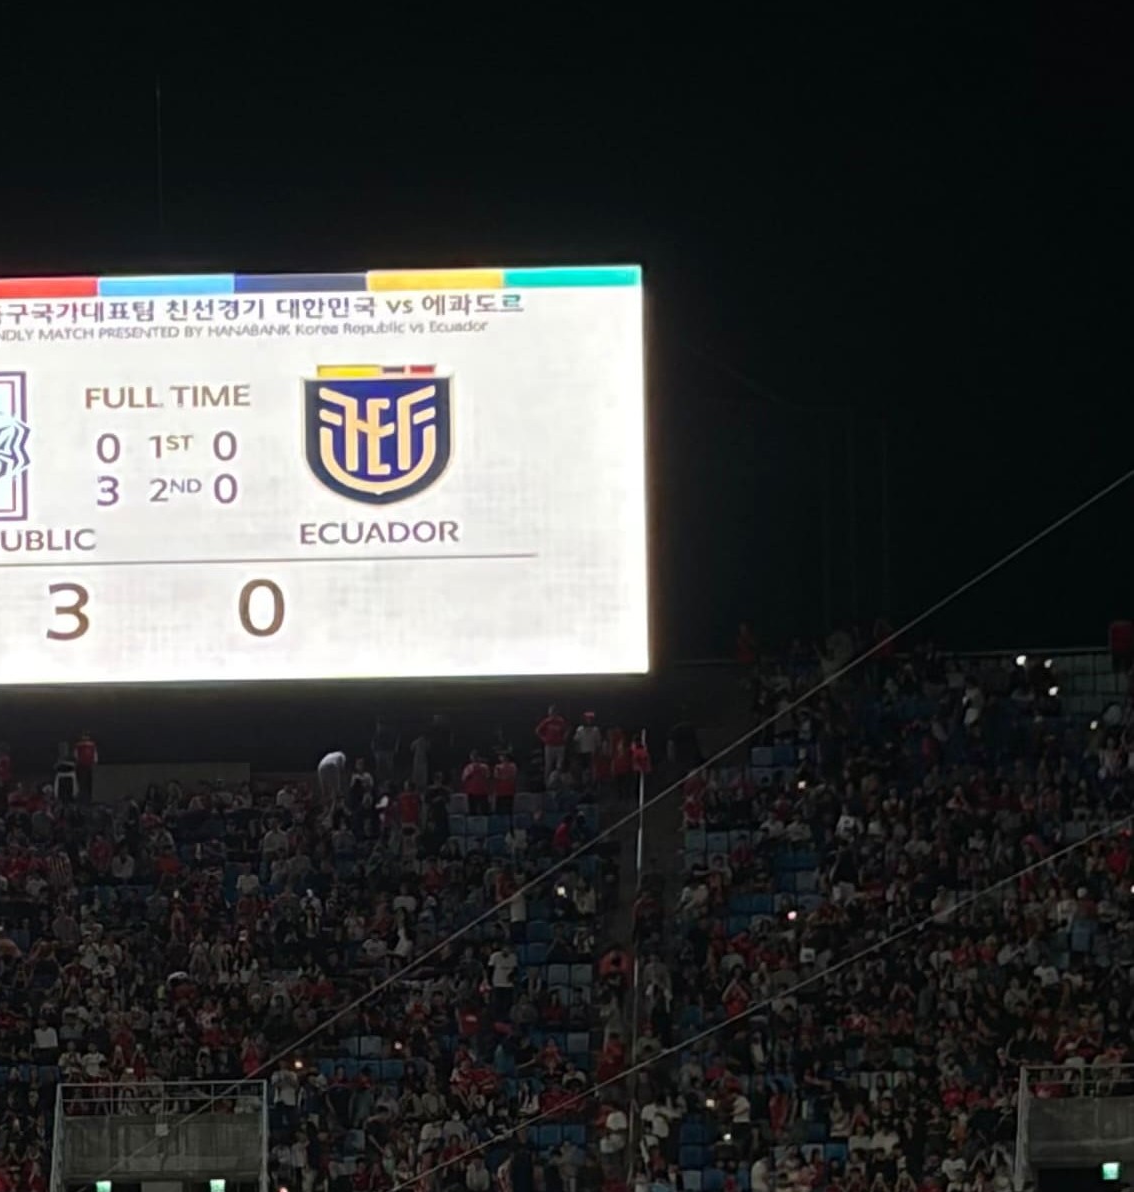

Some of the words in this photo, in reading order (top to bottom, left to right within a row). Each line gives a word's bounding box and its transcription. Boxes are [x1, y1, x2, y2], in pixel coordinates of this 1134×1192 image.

[166, 299, 265, 321] 친선경기
[276, 297, 377, 318] 대한민국
[38, 327, 95, 341] MATCH
[99, 325, 180, 340] PRESENTED
[185, 325, 204, 338] BY
[209, 324, 290, 338] HANABANK
[295, 322, 338, 335] Korea
[343, 321, 405, 335] Republic
[429, 320, 489, 333] Ecuador
[85, 386, 164, 409] FULL
[170, 384, 251, 408] TIME
[96, 432, 121, 464] 0
[213, 430, 237, 461] 0
[97, 475, 120, 506] 3
[213, 473, 238, 504] 0
[298, 520, 460, 546] ECUADOR
[46, 582, 91, 641] 3
[238, 578, 286, 637] 0
